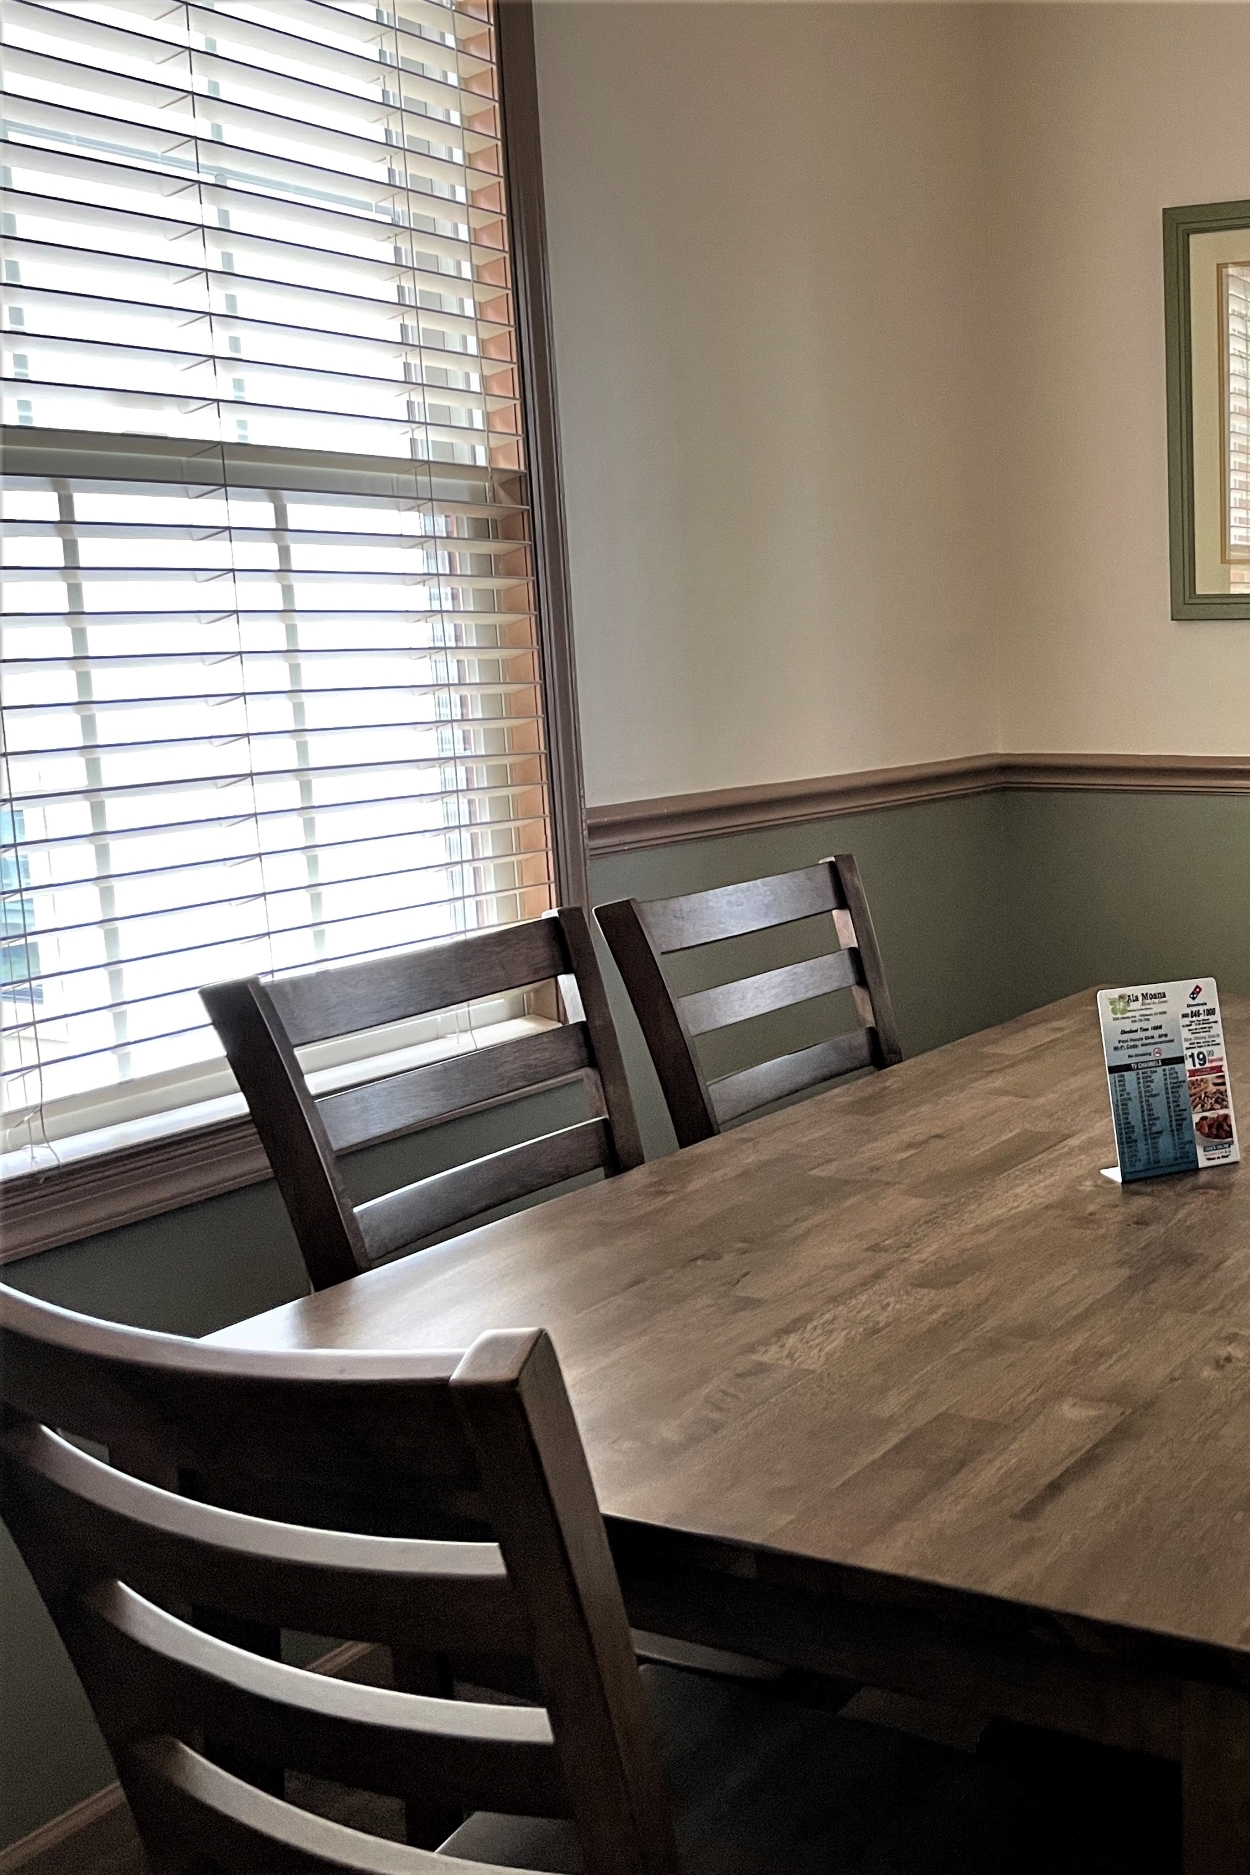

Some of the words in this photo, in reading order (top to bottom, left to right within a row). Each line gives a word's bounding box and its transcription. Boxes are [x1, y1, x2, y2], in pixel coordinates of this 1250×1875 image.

[1127, 994, 1139, 1003] Ala
[1141, 991, 1166, 1001] Moana
[1138, 1059, 1162, 1069] CHANNELS
